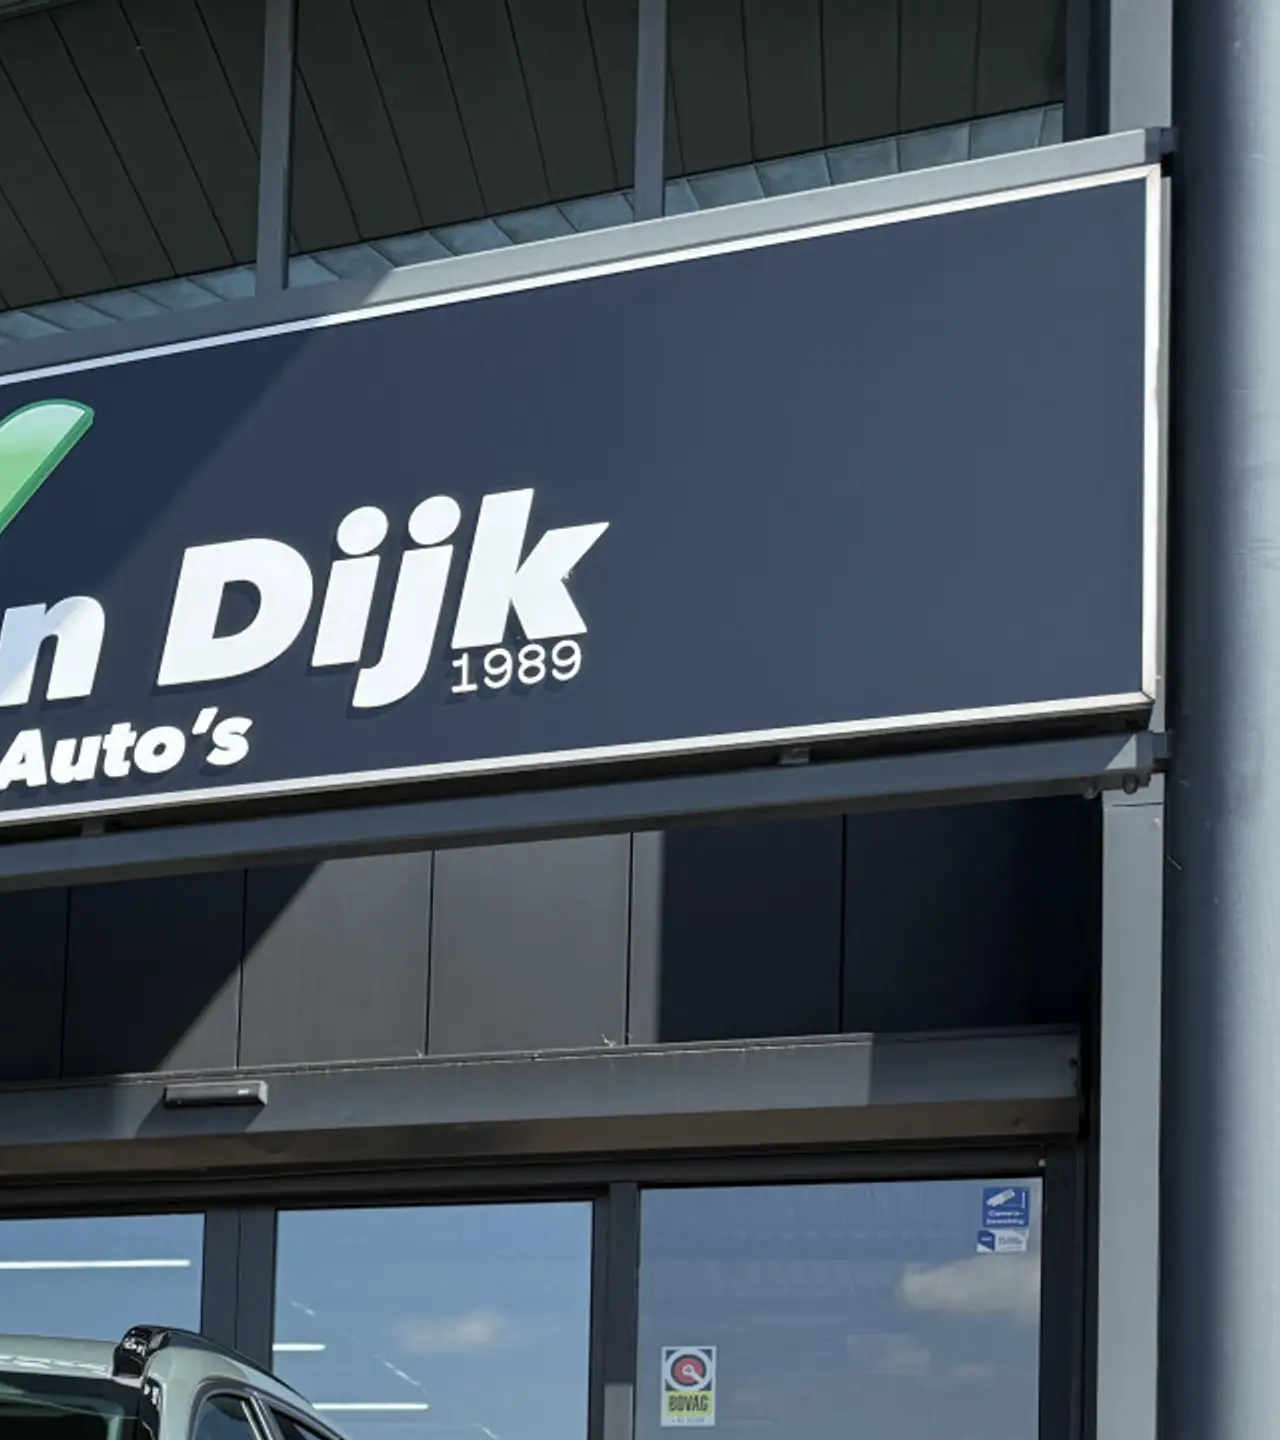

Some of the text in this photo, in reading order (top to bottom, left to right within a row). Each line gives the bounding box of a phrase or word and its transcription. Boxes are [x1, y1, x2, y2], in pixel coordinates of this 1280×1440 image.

[157, 488, 610, 708] Dijk
[451, 639, 582, 693] 1989
[669, 1394, 709, 1412] BOVAG
